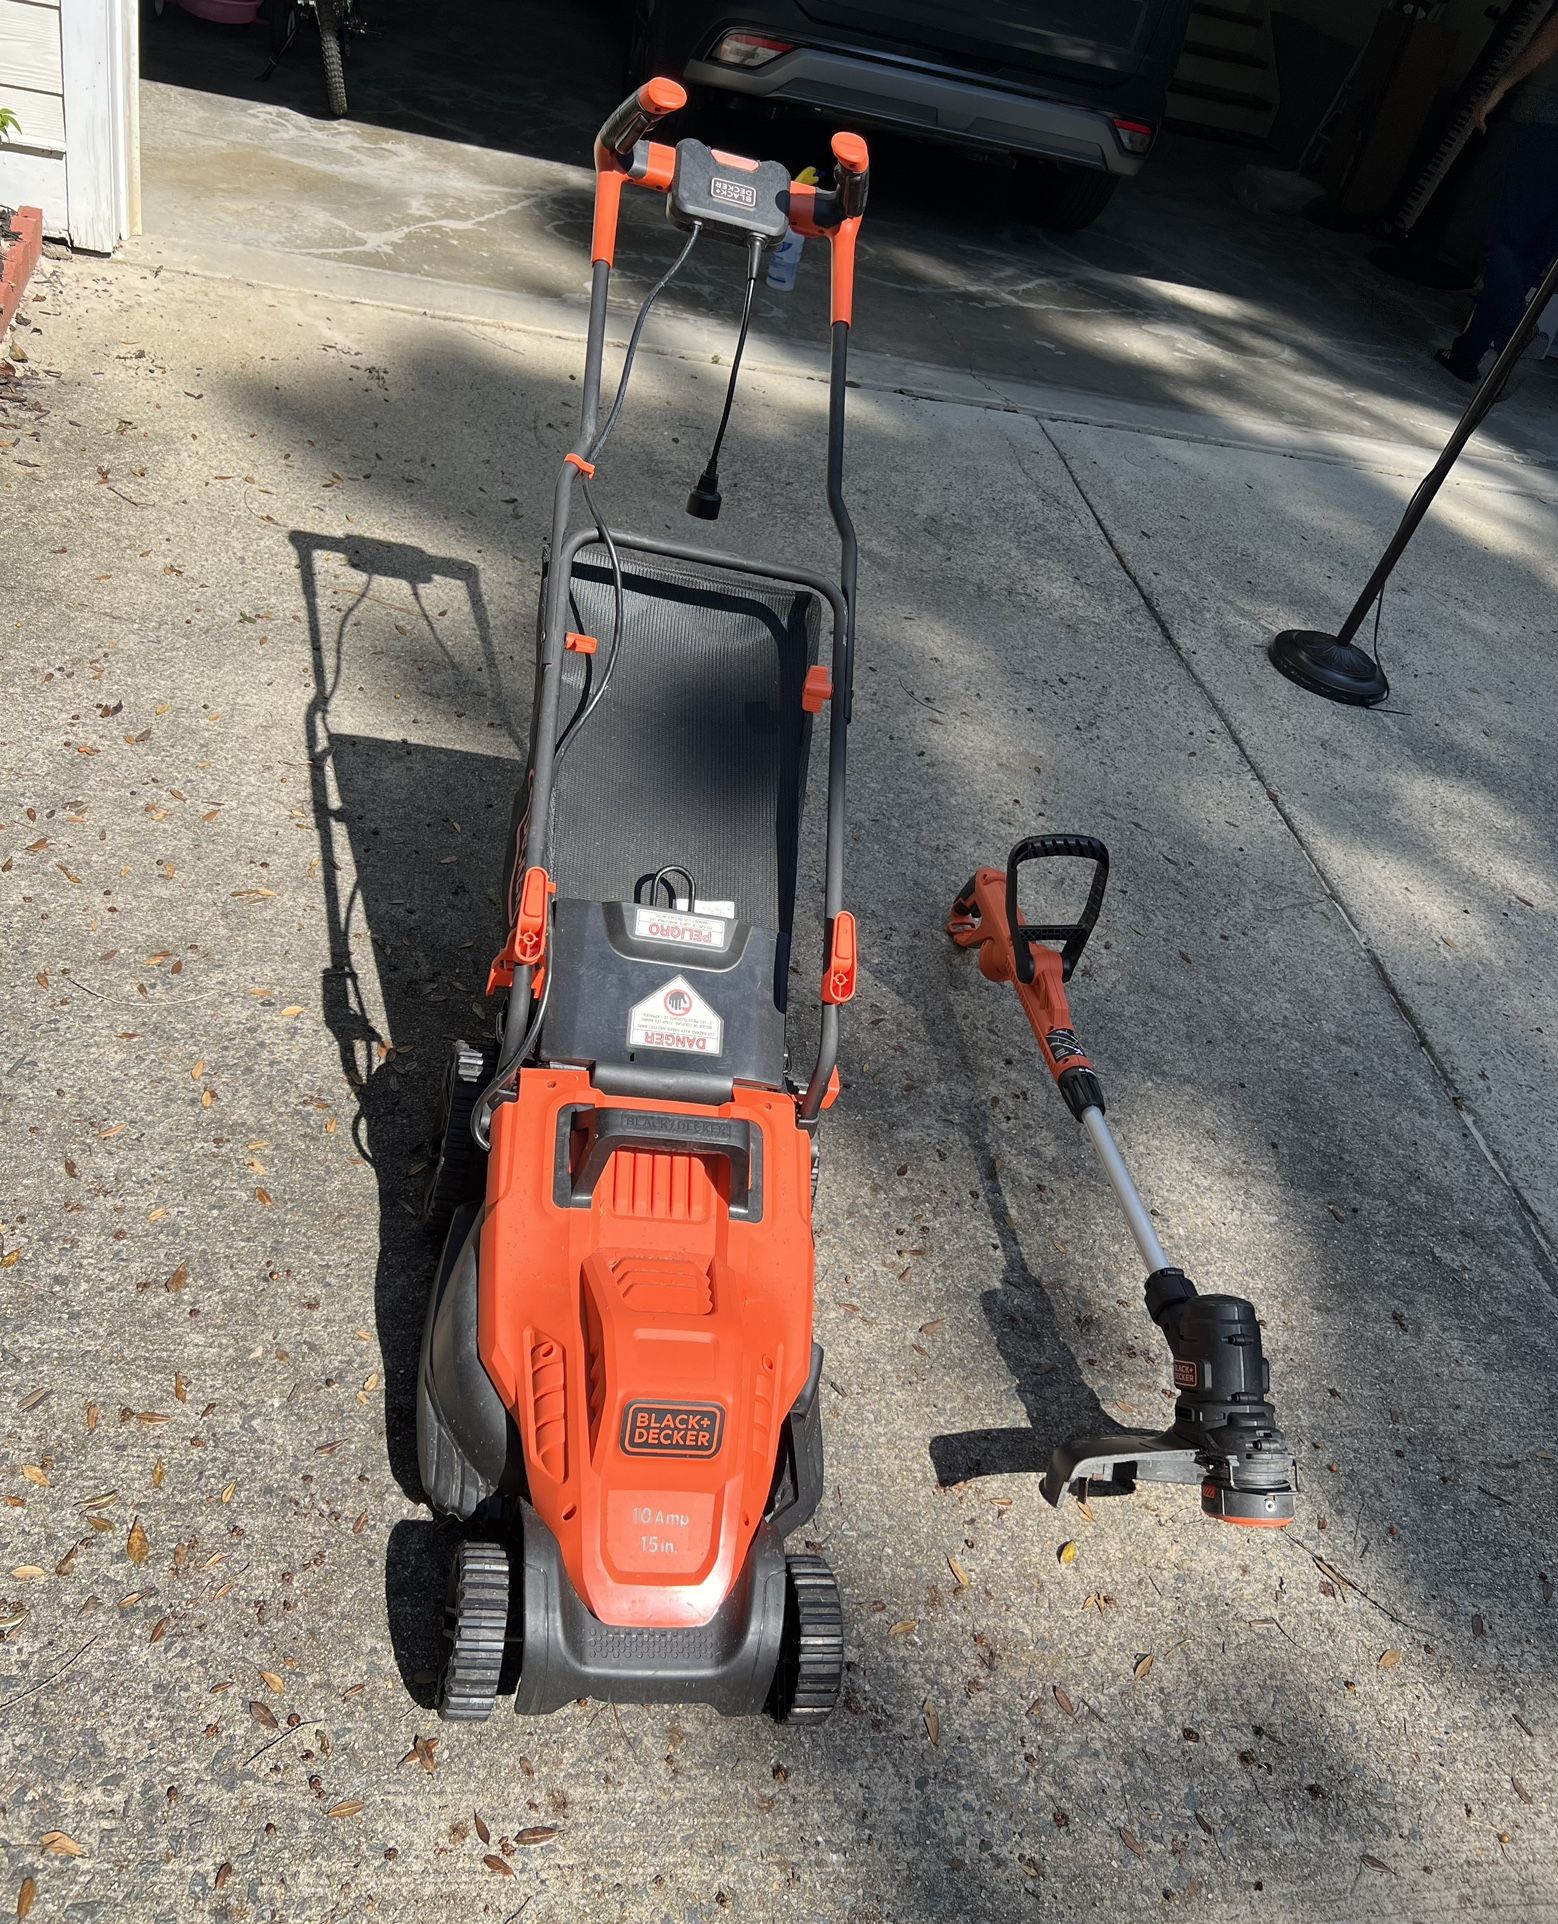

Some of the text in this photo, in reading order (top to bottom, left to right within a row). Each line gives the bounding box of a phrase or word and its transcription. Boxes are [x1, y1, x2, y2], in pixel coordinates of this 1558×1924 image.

[715, 181, 753, 196] DECKER
[715, 188, 752, 203] BLACK+
[648, 923, 712, 944] PELIGRO
[644, 1031, 707, 1051] DANGER
[636, 1412, 712, 1430] BLACK+
[633, 1428, 711, 1447] DECKER
[633, 1507, 690, 1527] 10 Amp
[641, 1536, 678, 1553] 15 in.
